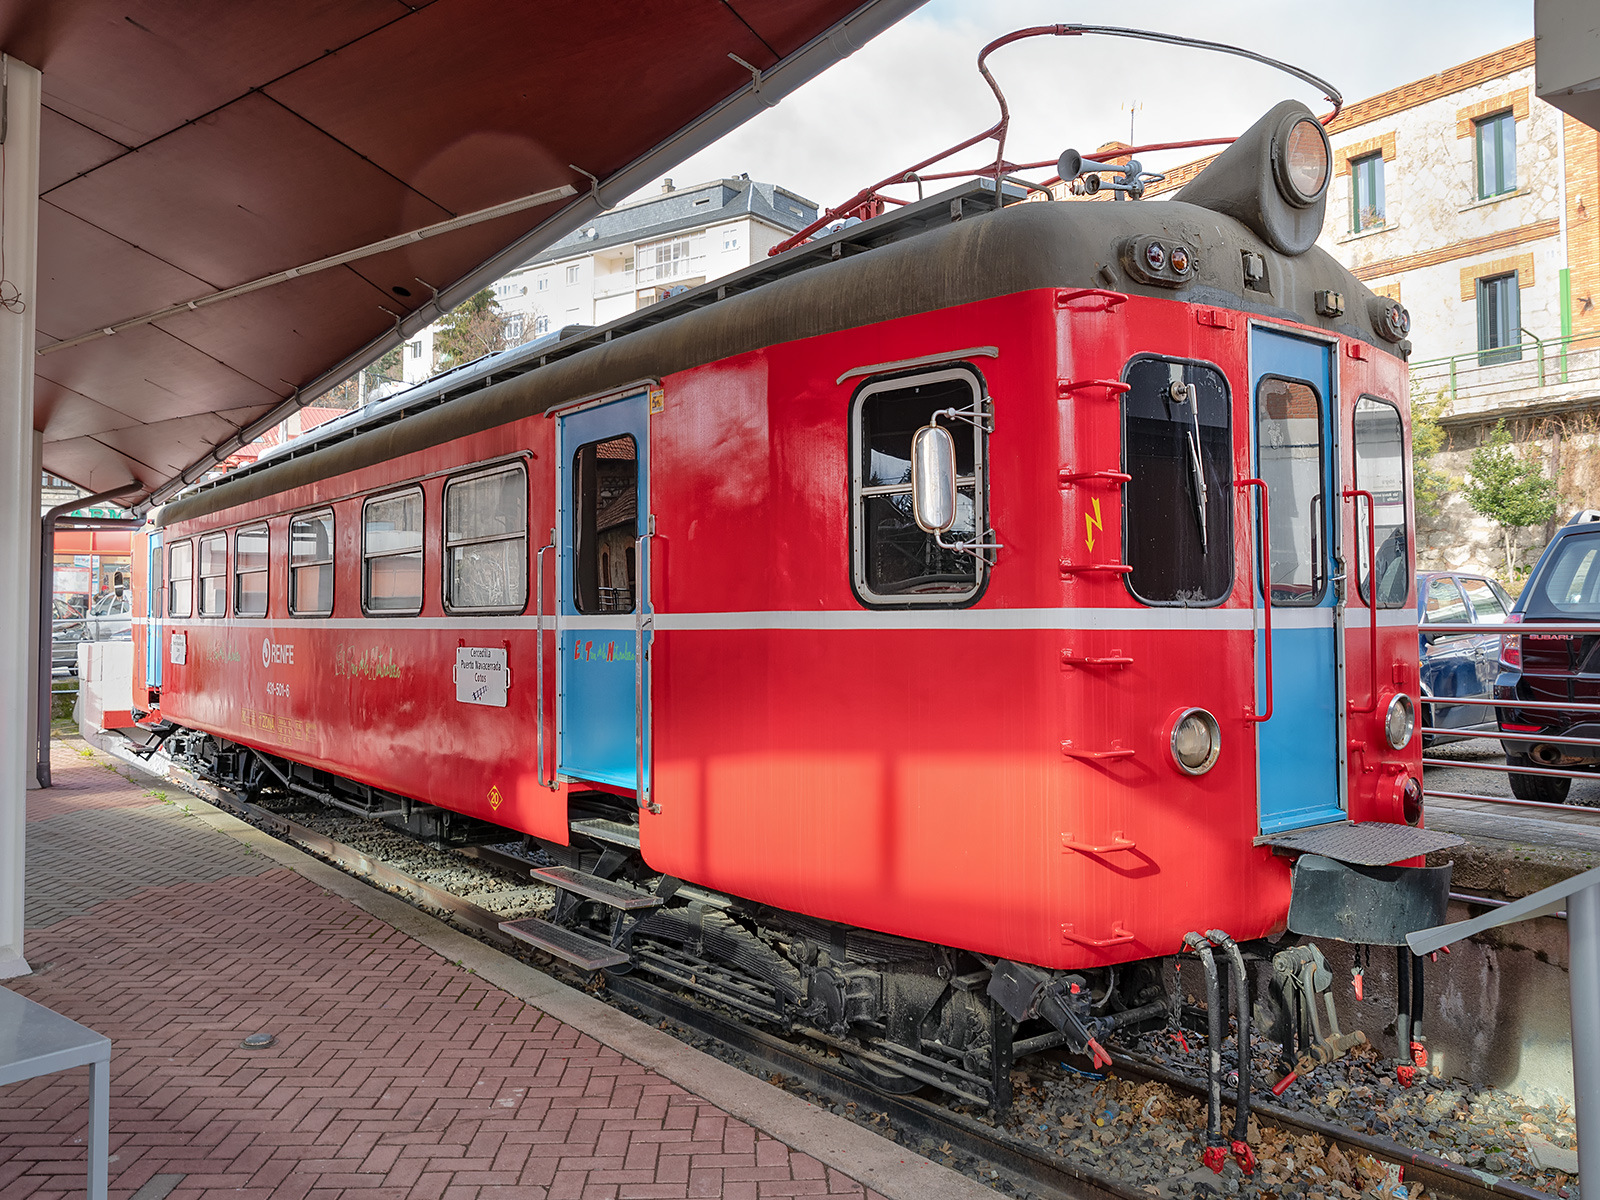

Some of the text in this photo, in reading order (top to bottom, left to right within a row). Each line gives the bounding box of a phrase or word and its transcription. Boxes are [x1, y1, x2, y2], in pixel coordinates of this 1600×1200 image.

[271, 644, 294, 664] RENFE
[470, 648, 491, 658] Cercedilla
[461, 660, 501, 671] Puerto Navacerrada
[474, 673, 486, 682] Cotos
[491, 792, 499, 804] 20
